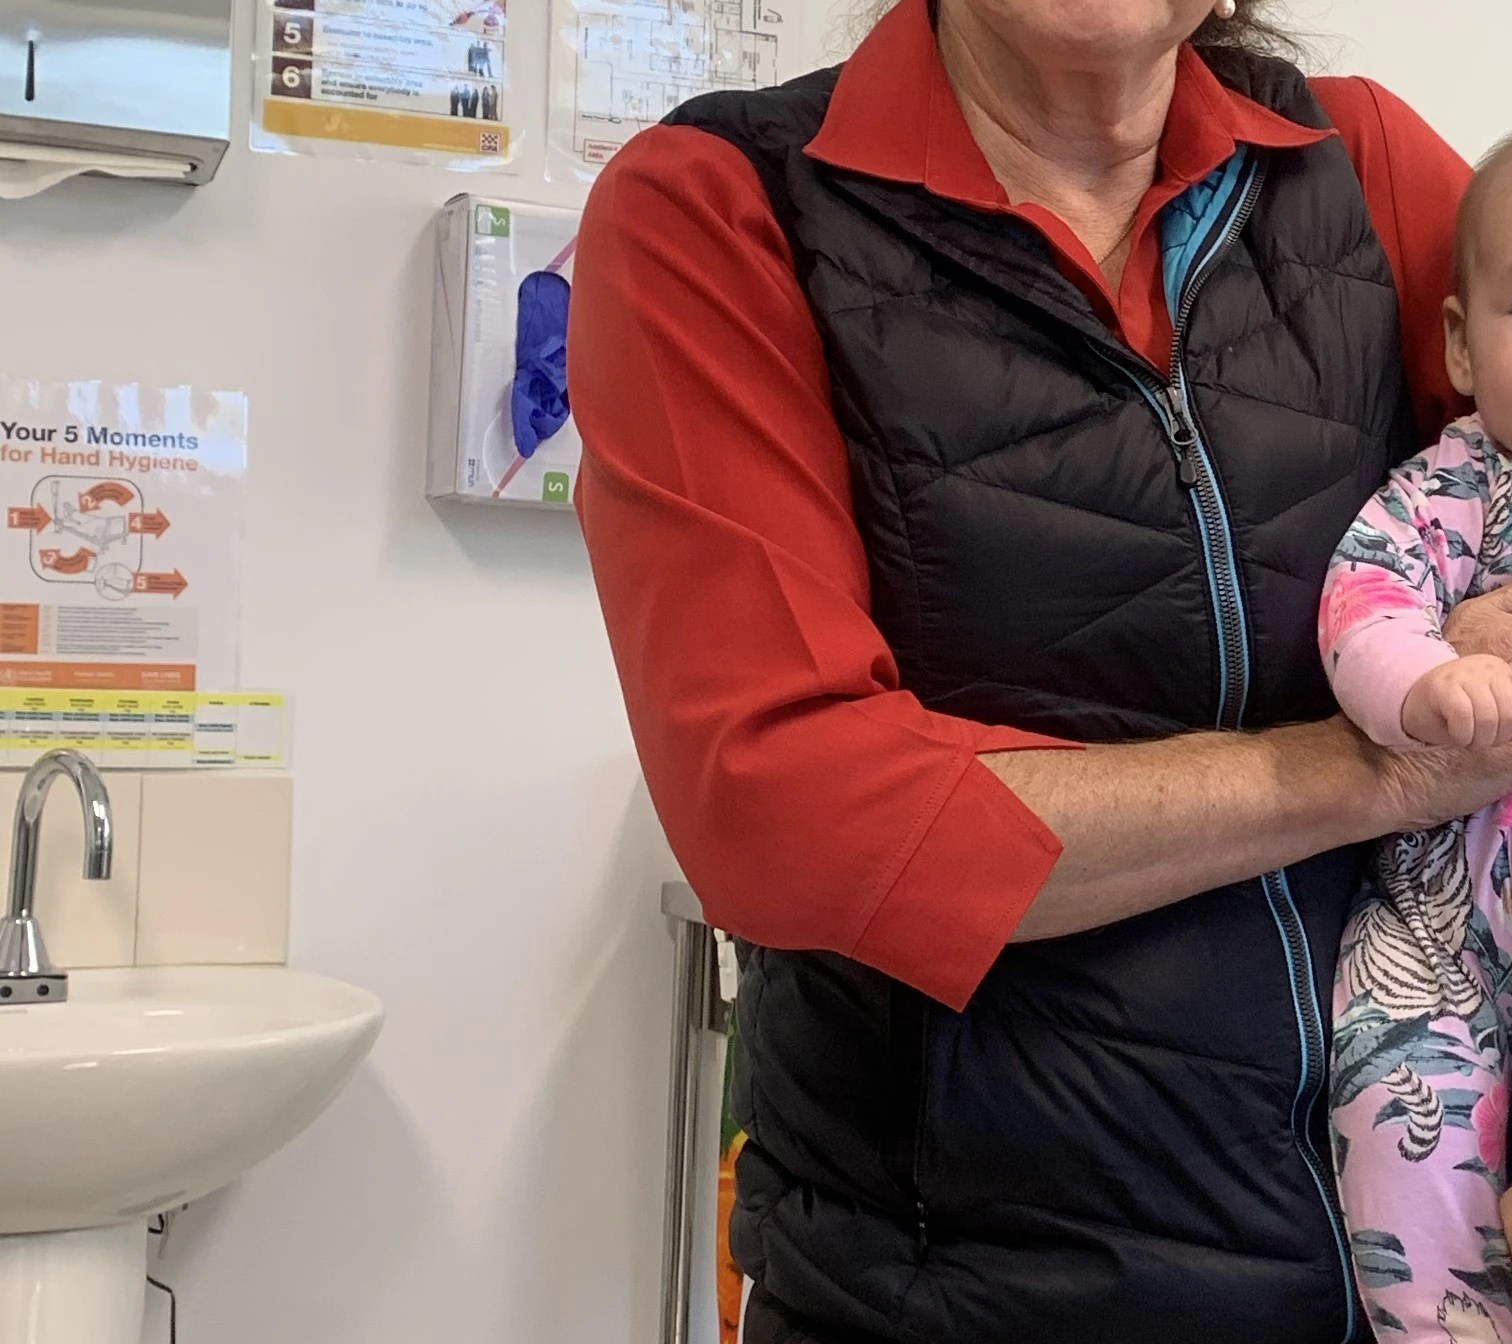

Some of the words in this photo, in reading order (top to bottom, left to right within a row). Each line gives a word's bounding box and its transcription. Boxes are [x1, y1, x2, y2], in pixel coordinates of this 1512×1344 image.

[283, 22, 301, 44] 5
[282, 65, 300, 88] 6
[0, 421, 57, 442] Your
[64, 425, 78, 443] 5
[87, 426, 199, 450] Moments
[0, 444, 32, 462] for
[40, 446, 100, 467] Hand
[109, 450, 199, 473] Hygiene
[548, 481, 564, 492] S
[82, 495, 96, 509] 2
[9, 513, 19, 526] 1
[130, 517, 142, 530] 4
[136, 576, 147, 590] 5
